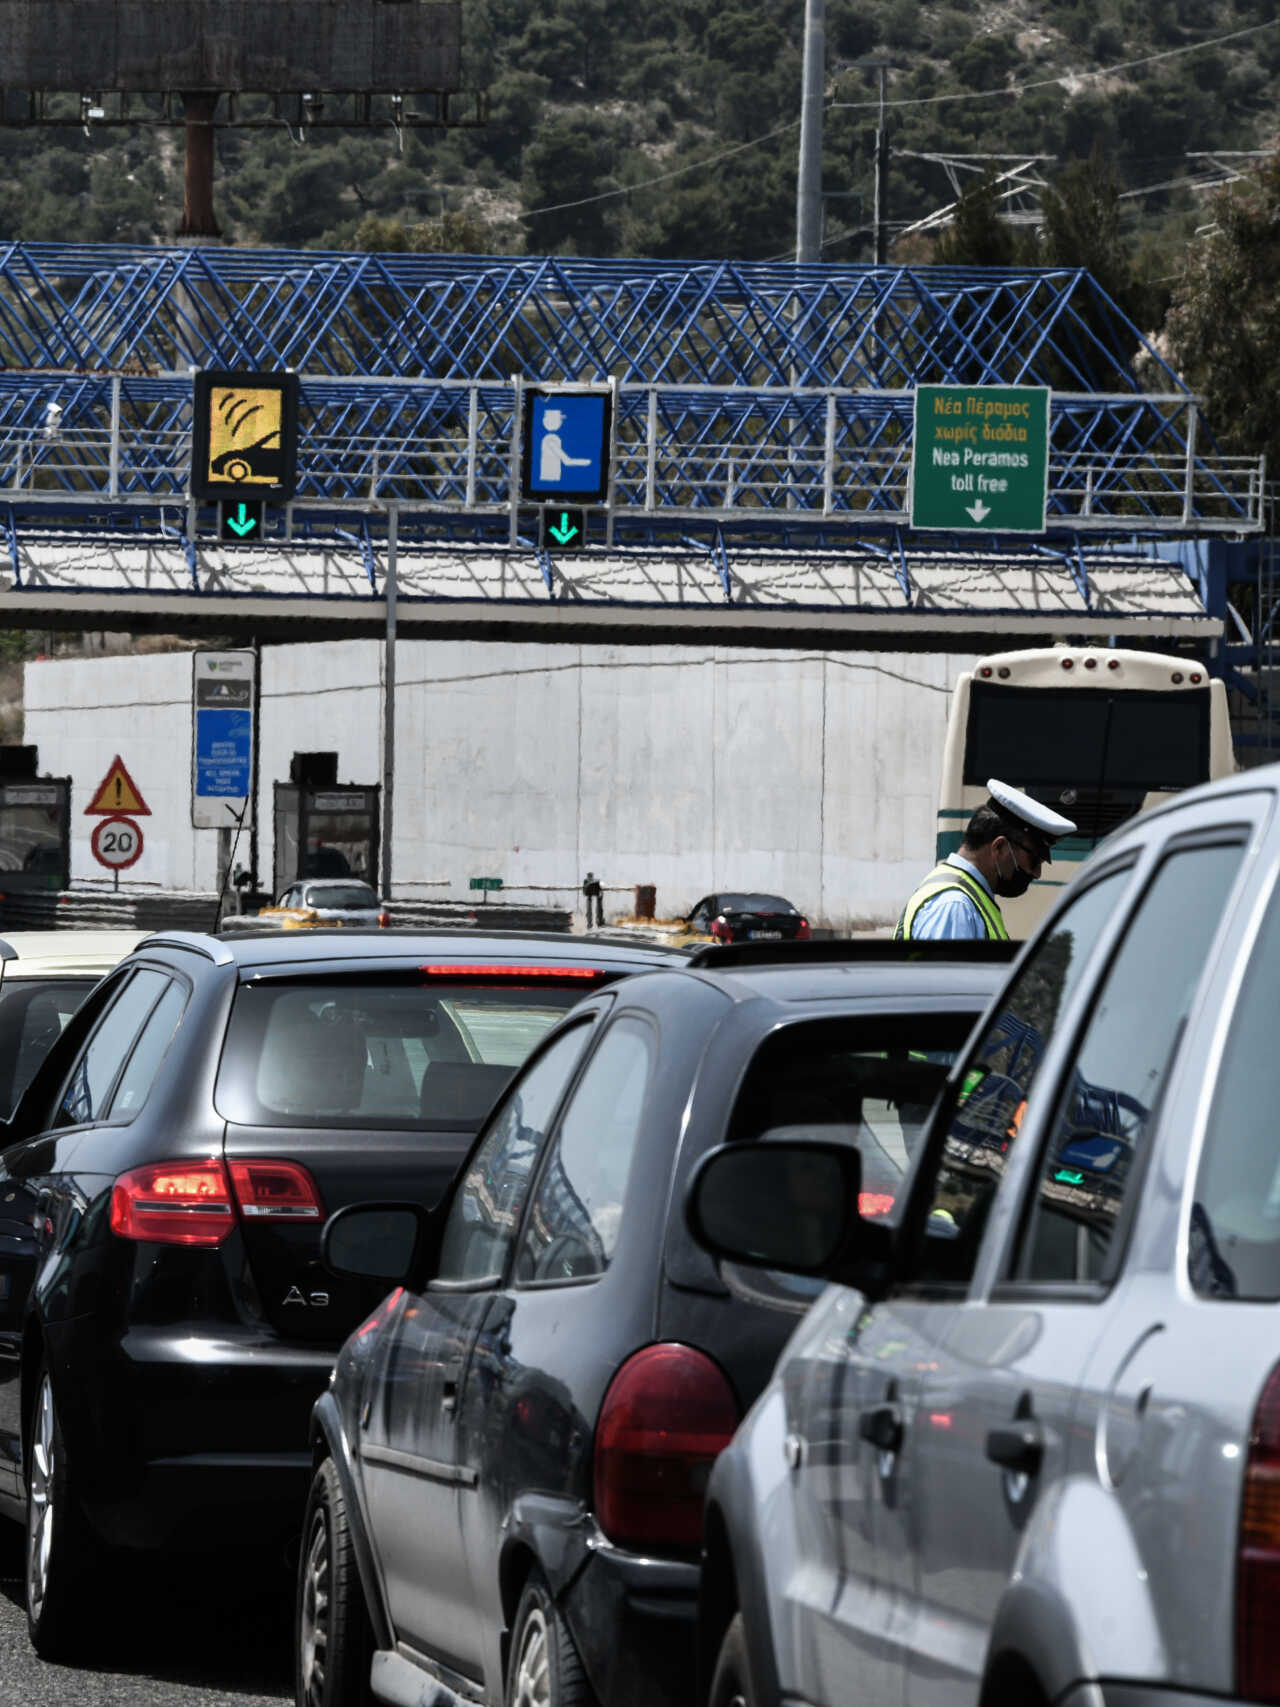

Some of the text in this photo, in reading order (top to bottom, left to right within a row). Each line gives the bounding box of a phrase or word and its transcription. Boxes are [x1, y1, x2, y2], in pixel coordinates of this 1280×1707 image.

[934, 396, 1030, 419] Νέα Πέραμος
[935, 421, 1027, 445] χωρίς διόδια
[932, 447, 1029, 467] Nea Peramos
[951, 473, 1008, 493] toll free
[103, 832, 132, 853] 20
[282, 1285, 329, 1306] A3
